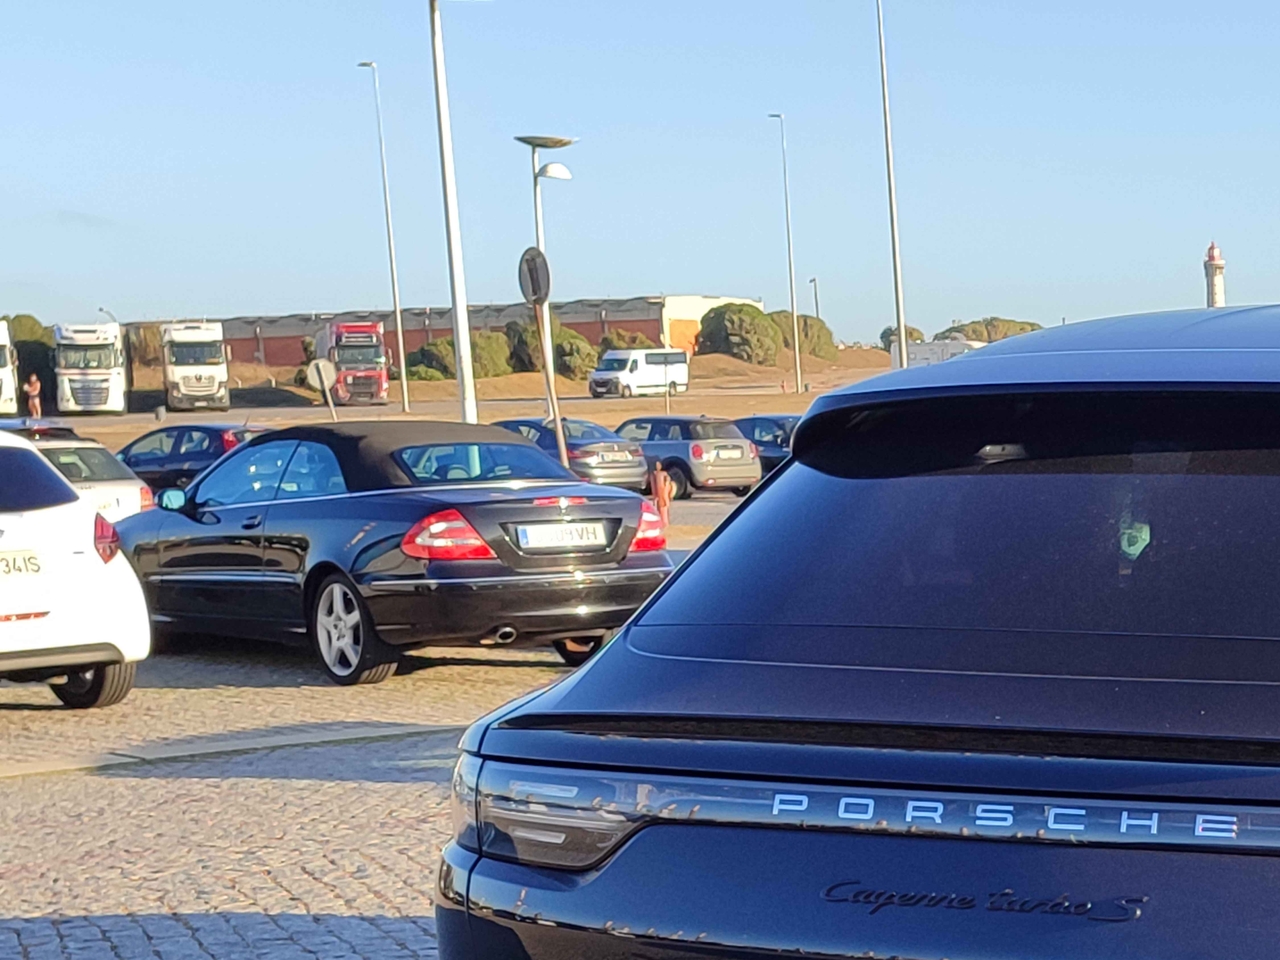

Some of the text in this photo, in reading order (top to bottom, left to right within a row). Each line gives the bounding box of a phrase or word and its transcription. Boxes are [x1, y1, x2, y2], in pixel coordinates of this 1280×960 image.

[772, 793, 1240, 838] PORSCHE
[819, 880, 977, 915] Cayenne
[1087, 896, 1150, 922] S
